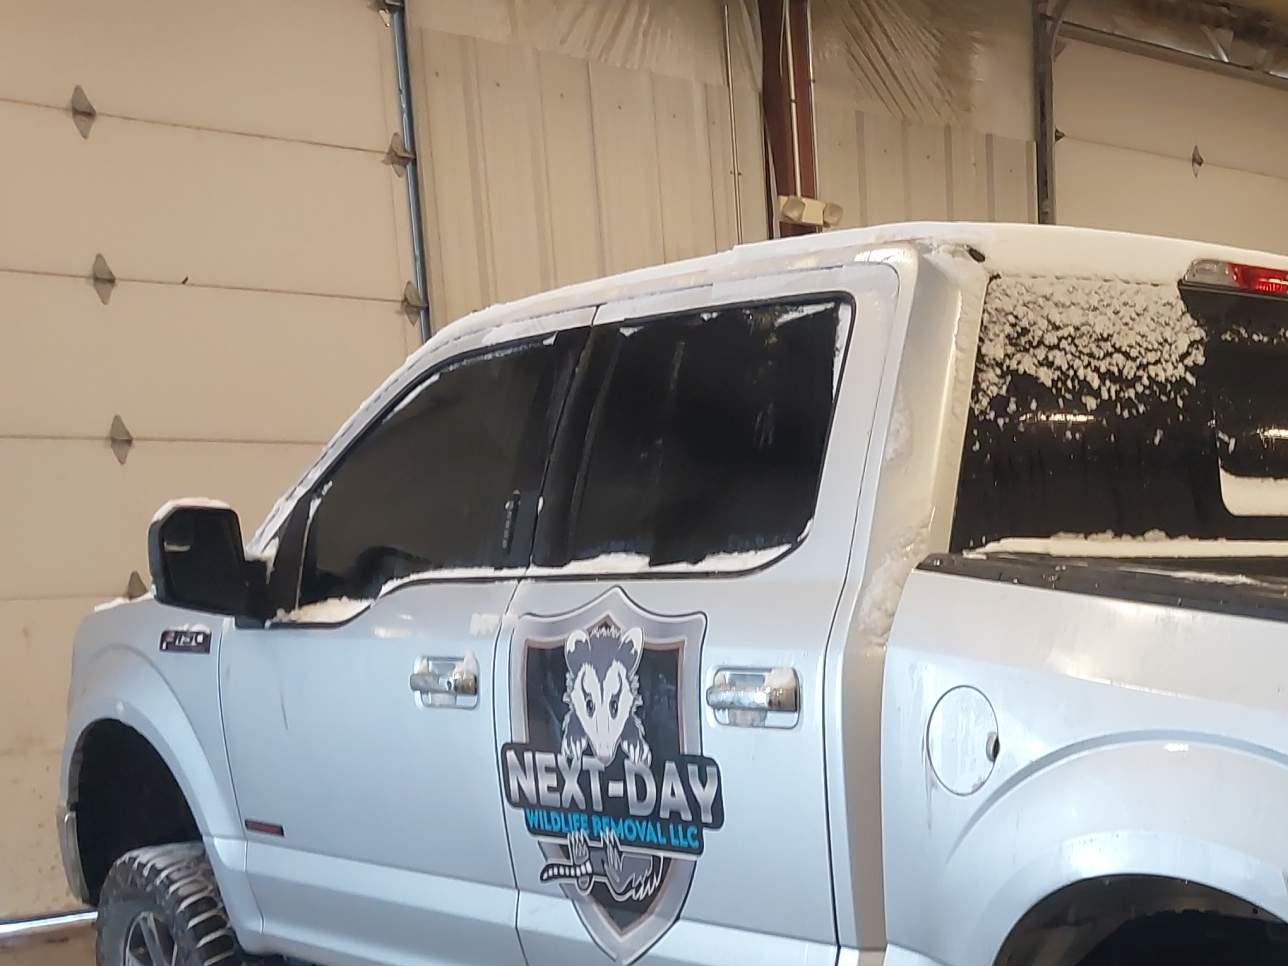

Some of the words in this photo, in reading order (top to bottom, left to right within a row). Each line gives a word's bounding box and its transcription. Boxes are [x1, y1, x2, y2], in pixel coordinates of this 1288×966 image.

[506, 749, 719, 824] NEXT-DAY
[526, 808, 589, 835] WILDLIFE
[592, 815, 666, 845] REMOVAL
[669, 823, 699, 848] LLC
